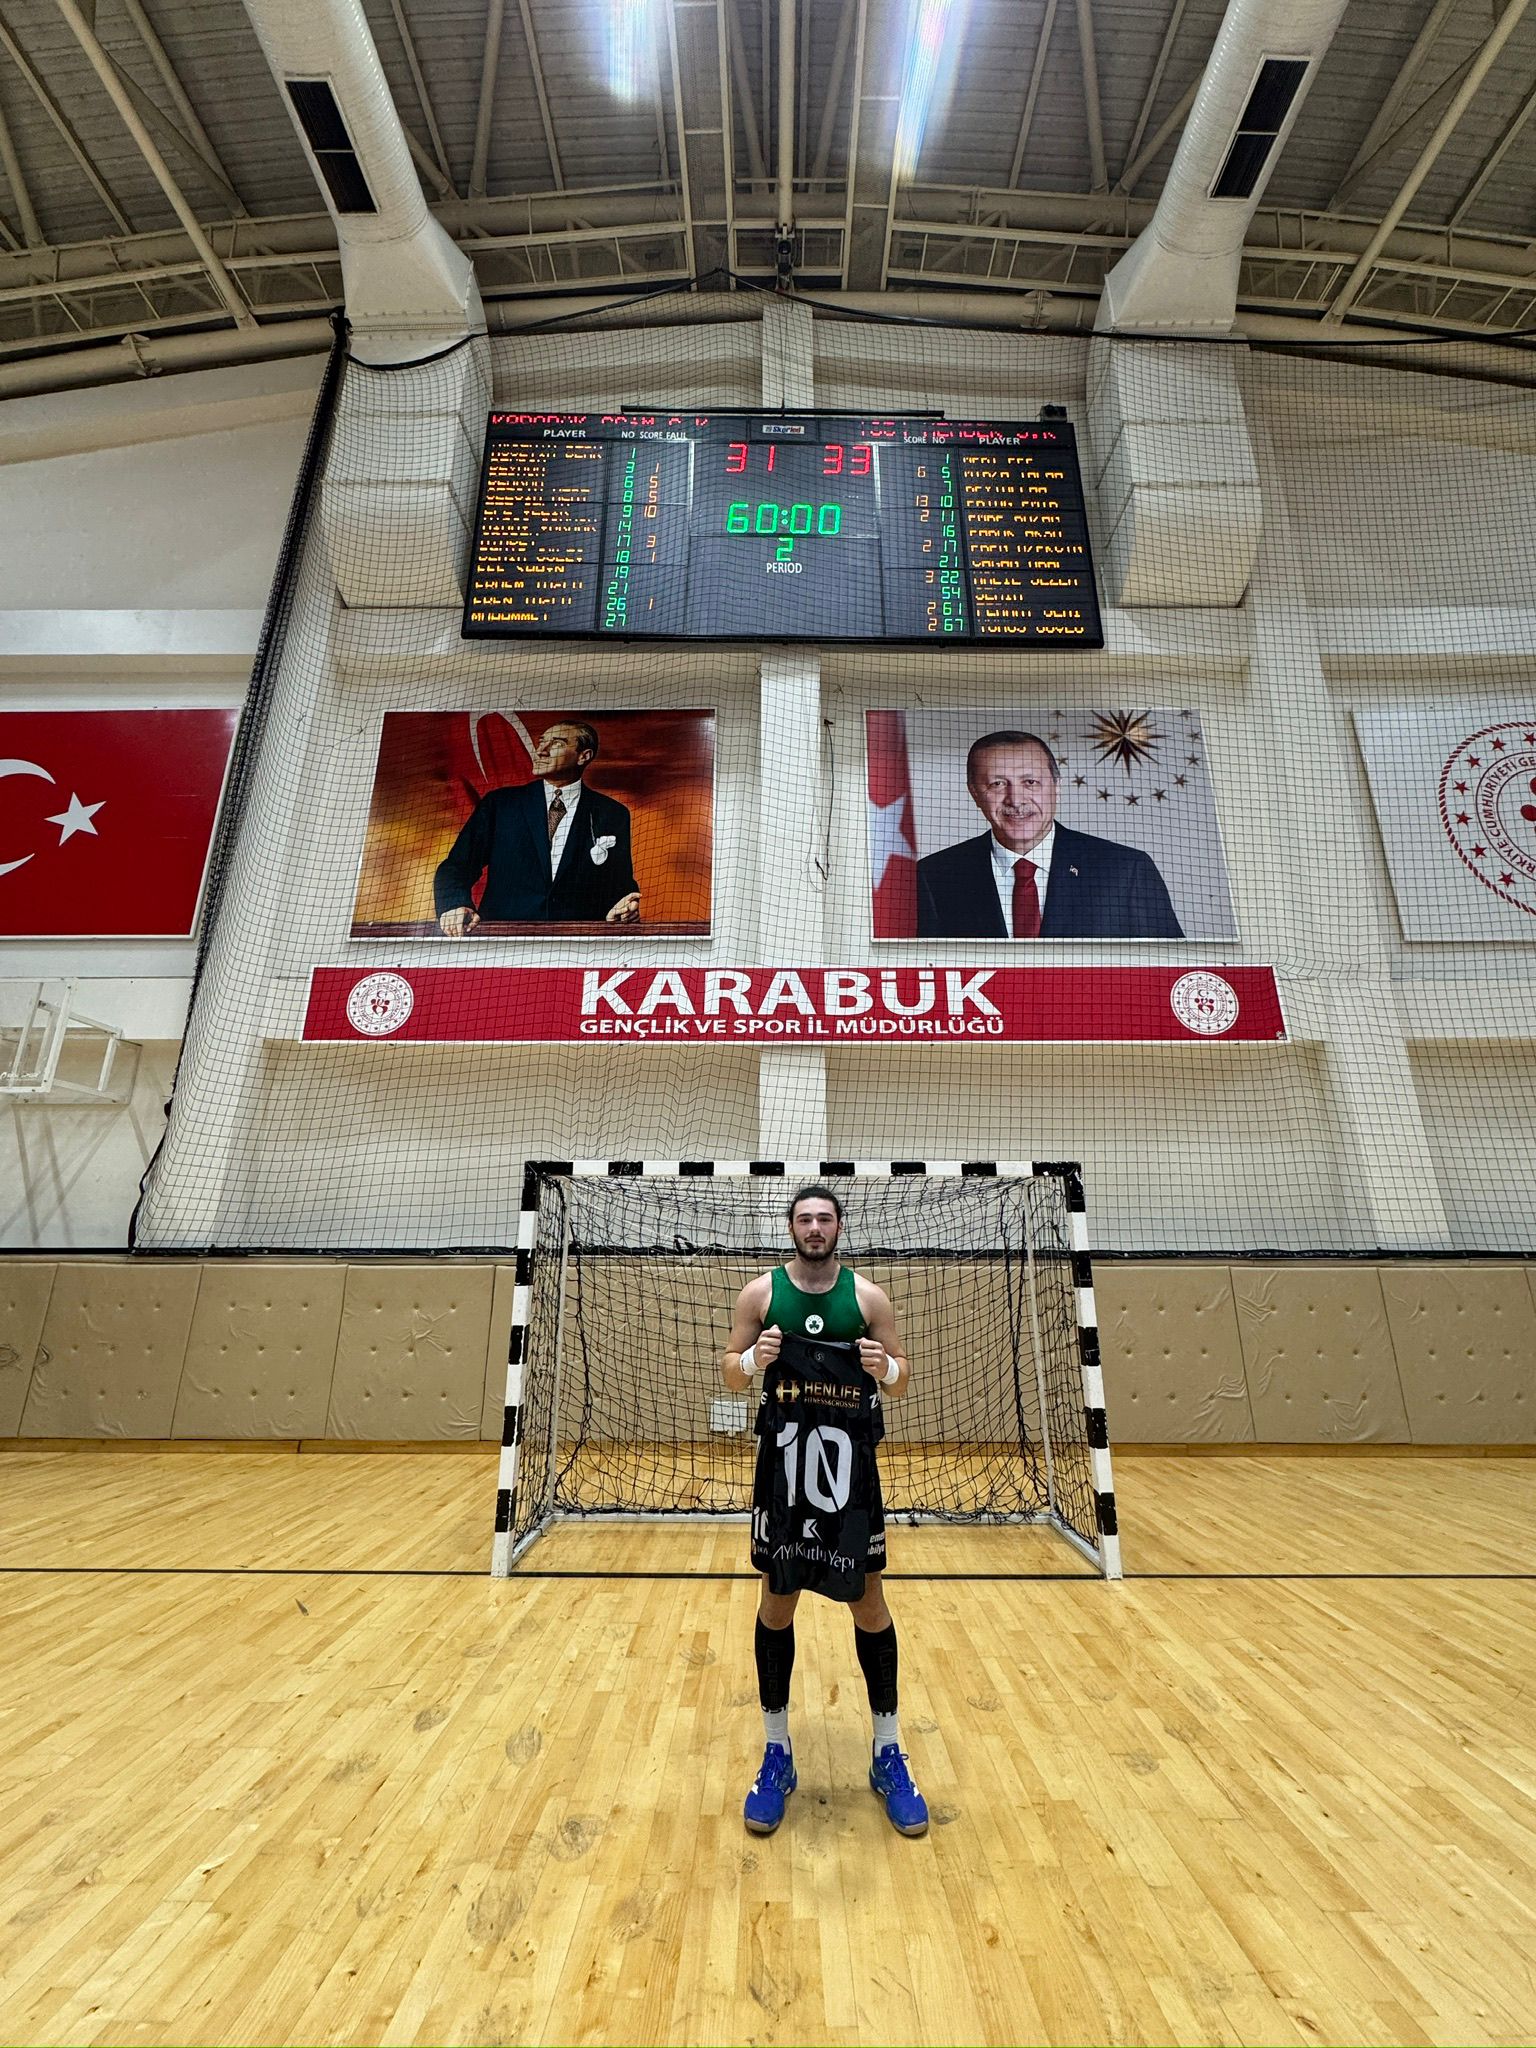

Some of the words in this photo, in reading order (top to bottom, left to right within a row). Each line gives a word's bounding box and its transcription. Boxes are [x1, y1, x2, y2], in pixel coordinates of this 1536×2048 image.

[543, 429, 587, 438] PLAYER
[622, 431, 635, 439] NO
[639, 431, 664, 439] SCORE
[666, 432, 688, 440] FAUL
[903, 436, 927, 444] SCORE
[979, 437, 1021, 445] PLAYER
[725, 443, 776, 473] 31
[823, 445, 871, 474] 33
[625, 461, 636, 474] 3
[917, 465, 926, 478] 6
[941, 466, 951, 479] 5
[624, 475, 634, 489] 6
[649, 475, 658, 489] 5
[943, 480, 952, 493] 7
[622, 490, 634, 503] 8
[648, 490, 657, 503] 5
[915, 494, 929, 507] 13
[940, 495, 953, 508] 10
[622, 505, 633, 518] 9
[643, 505, 657, 518] 10
[920, 509, 930, 522] 2
[941, 510, 954, 522] 11
[618, 520, 632, 532] 14
[726, 503, 842, 535] 60:00
[942, 524, 955, 537] 16
[617, 534, 631, 547] 17
[646, 535, 656, 548] 3
[922, 539, 932, 552] 2
[943, 539, 957, 552] 17
[616, 550, 630, 563] 18
[775, 537, 795, 562] 2
[766, 562, 803, 574] PERIOD
[939, 555, 958, 568] 21
[615, 565, 629, 579] 19
[925, 570, 934, 583] 3
[940, 570, 959, 584] 22
[607, 581, 628, 595] 21
[941, 586, 961, 600] 54
[606, 597, 627, 611] 26
[927, 601, 937, 615] 2
[942, 601, 962, 616] 61
[605, 612, 627, 627] 27
[928, 618, 938, 632] 2
[943, 618, 964, 632] 67
[1482, 758, 1518, 838] CUMHURİYETİ
[580, 970, 1003, 1016] KARABÜK
[579, 1016, 690, 1038] GENÇLİK
[693, 1019, 727, 1034] VE
[733, 1018, 801, 1034] SPOR
[807, 1016, 830, 1034] İL
[835, 1016, 1004, 1034] MÜDÜRLÜĞÜ
[804, 1380, 862, 1401] HENLIFE
[803, 1396, 860, 1409] FITNESS&CROSSFIT
[776, 1421, 853, 1513] 10
